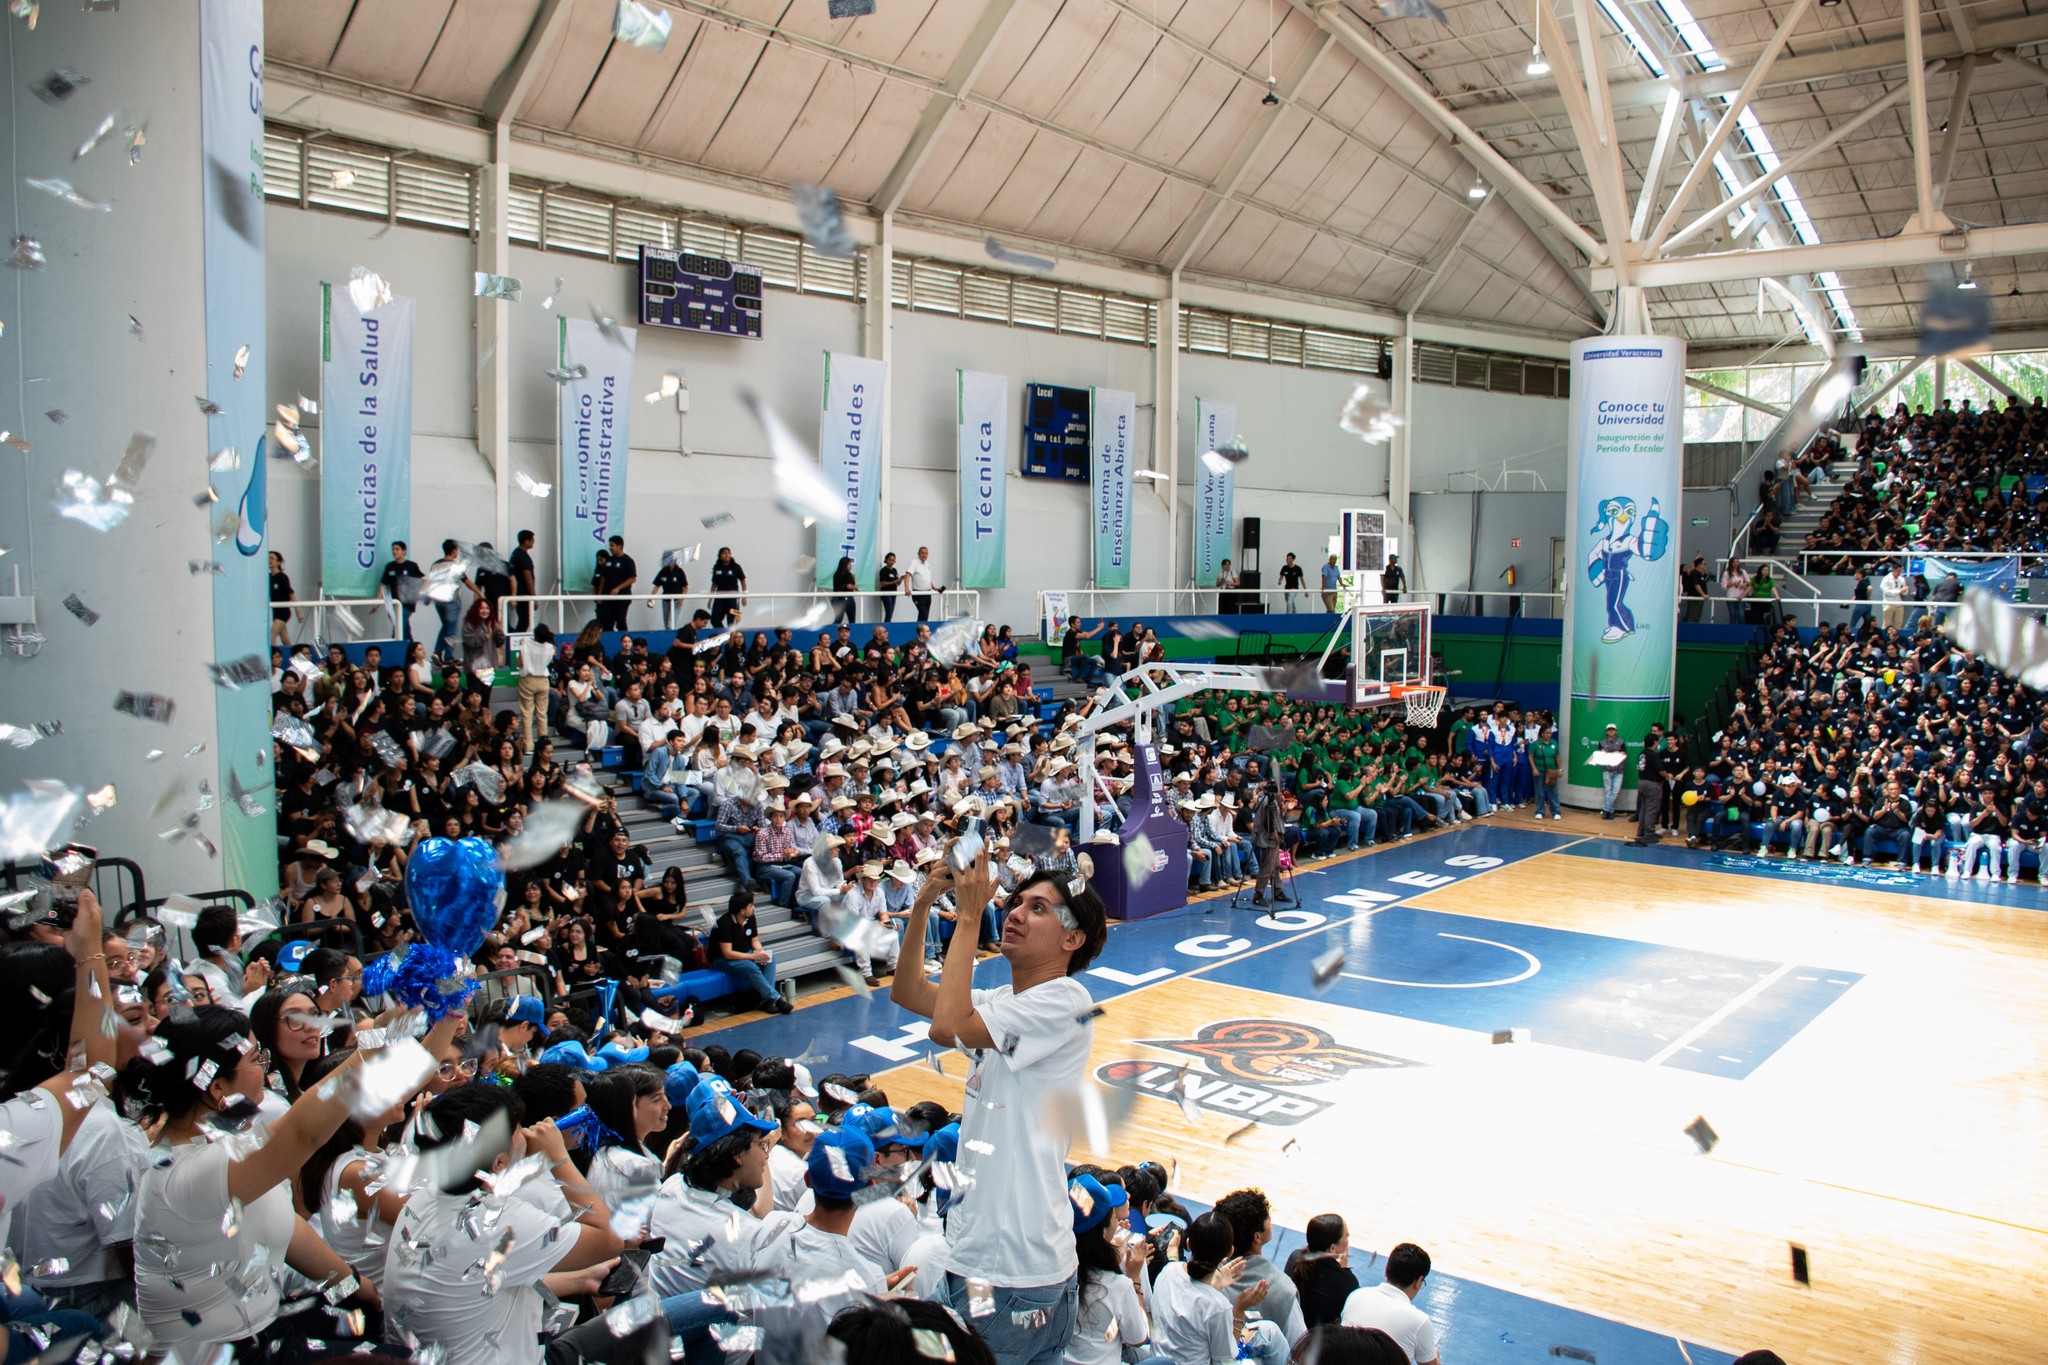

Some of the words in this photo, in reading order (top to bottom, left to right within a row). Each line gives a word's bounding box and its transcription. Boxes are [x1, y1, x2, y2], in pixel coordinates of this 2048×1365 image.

[360, 317, 379, 387] Salud
[1620, 349, 1661, 358] Veracruzana
[359, 395, 377, 416] la
[1037, 386, 1053, 398] Local
[1597, 414, 1665, 425] Universidad
[1598, 400, 1648, 413] Conoce
[1652, 402, 1665, 412] tu
[358, 425, 377, 455] de
[591, 375, 615, 544] Administrativa
[1101, 443, 1112, 464] de
[1114, 414, 1126, 477] Abierta
[1204, 413, 1216, 493] Veruzana
[1596, 433, 1651, 443] Inauguración
[1652, 433, 1664, 441] del
[1596, 444, 1631, 454] Periodo
[1633, 443, 1665, 453] Escolar
[840, 383, 864, 564] Humanidades
[975, 421, 993, 540] Técnica
[1101, 469, 1111, 535] Sistema
[358, 463, 377, 569] Ciencias
[1112, 481, 1124, 567] Enseñanza
[1204, 494, 1214, 573] Universidad
[848, 853, 1504, 1062] HLCONES
[1136, 1065, 1319, 1118] LNBP
